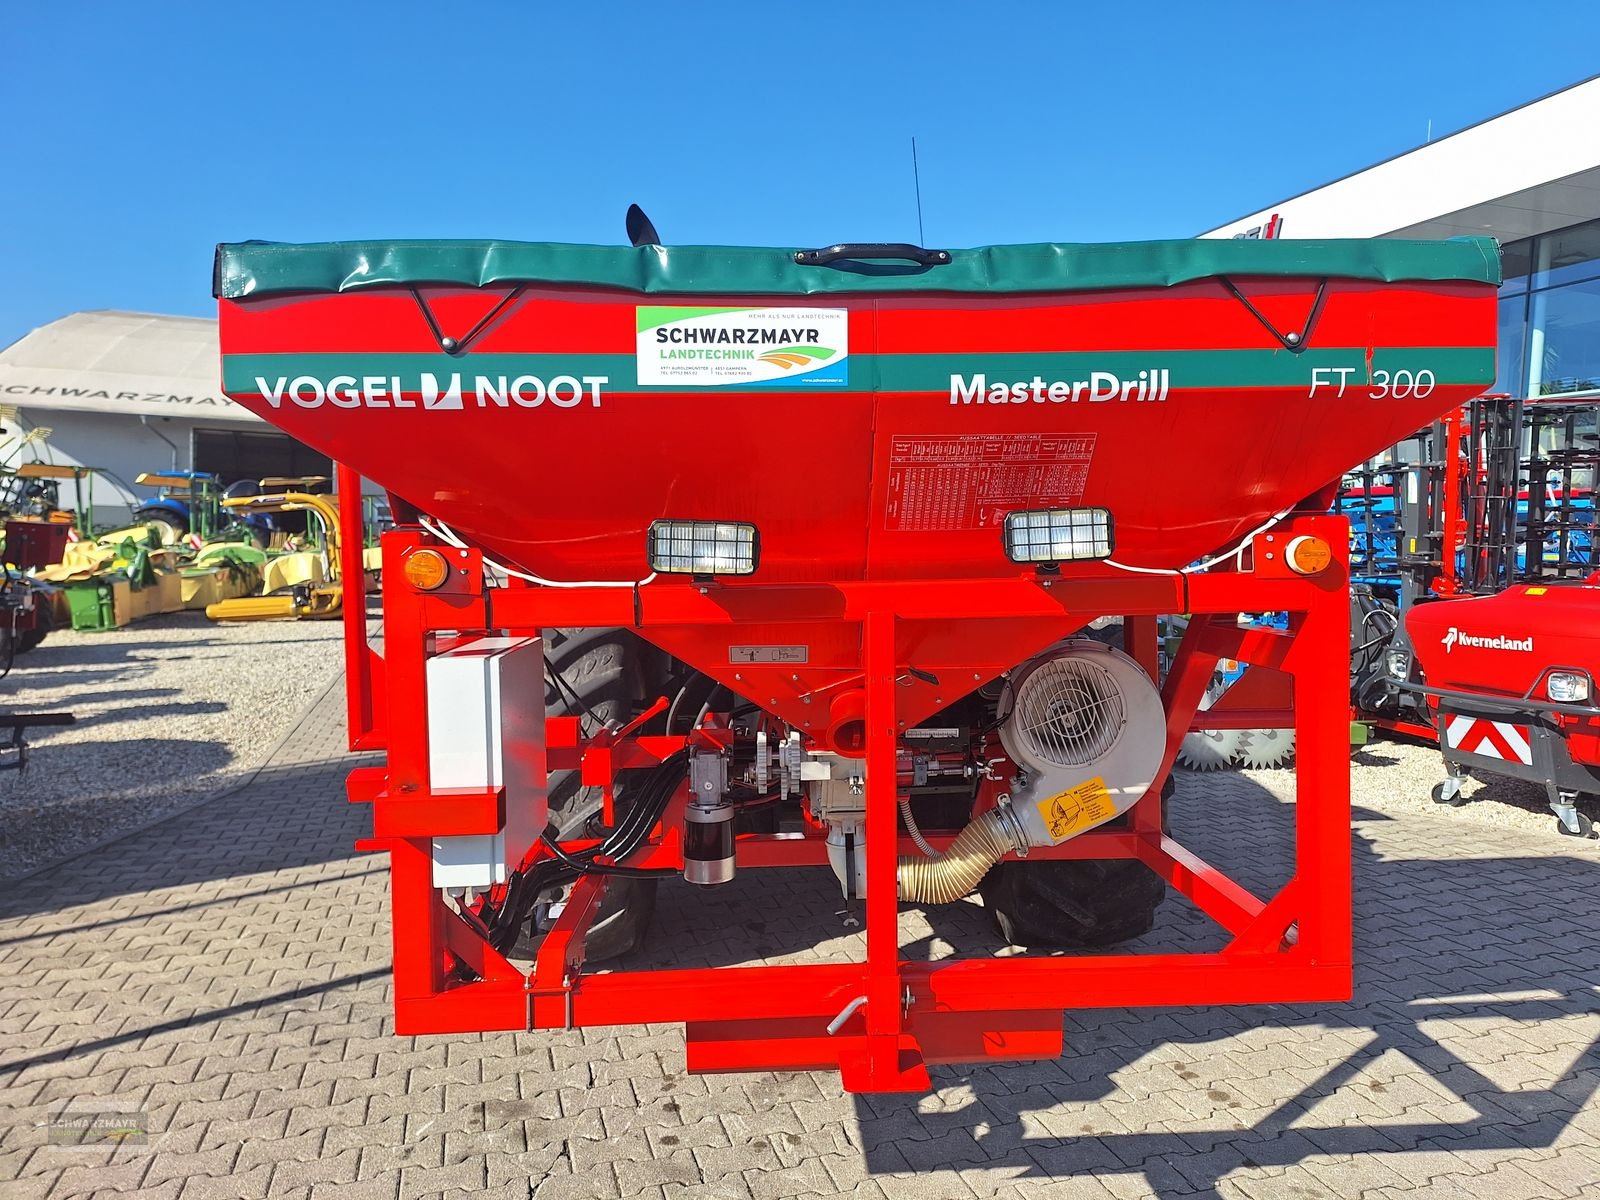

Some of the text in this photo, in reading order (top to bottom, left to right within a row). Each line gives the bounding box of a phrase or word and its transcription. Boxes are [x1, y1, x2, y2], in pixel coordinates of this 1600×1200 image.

[656, 327, 819, 344] SCHWARZMAYR
[659, 349, 755, 360] LANDTECHNIK
[0, 383, 234, 407] CHWARZMAY
[254, 375, 609, 409] VOGEL NOOT
[950, 368, 1170, 404] MasterDrill
[1308, 367, 1436, 400] FT 300
[1458, 631, 1533, 651] Kverneland
